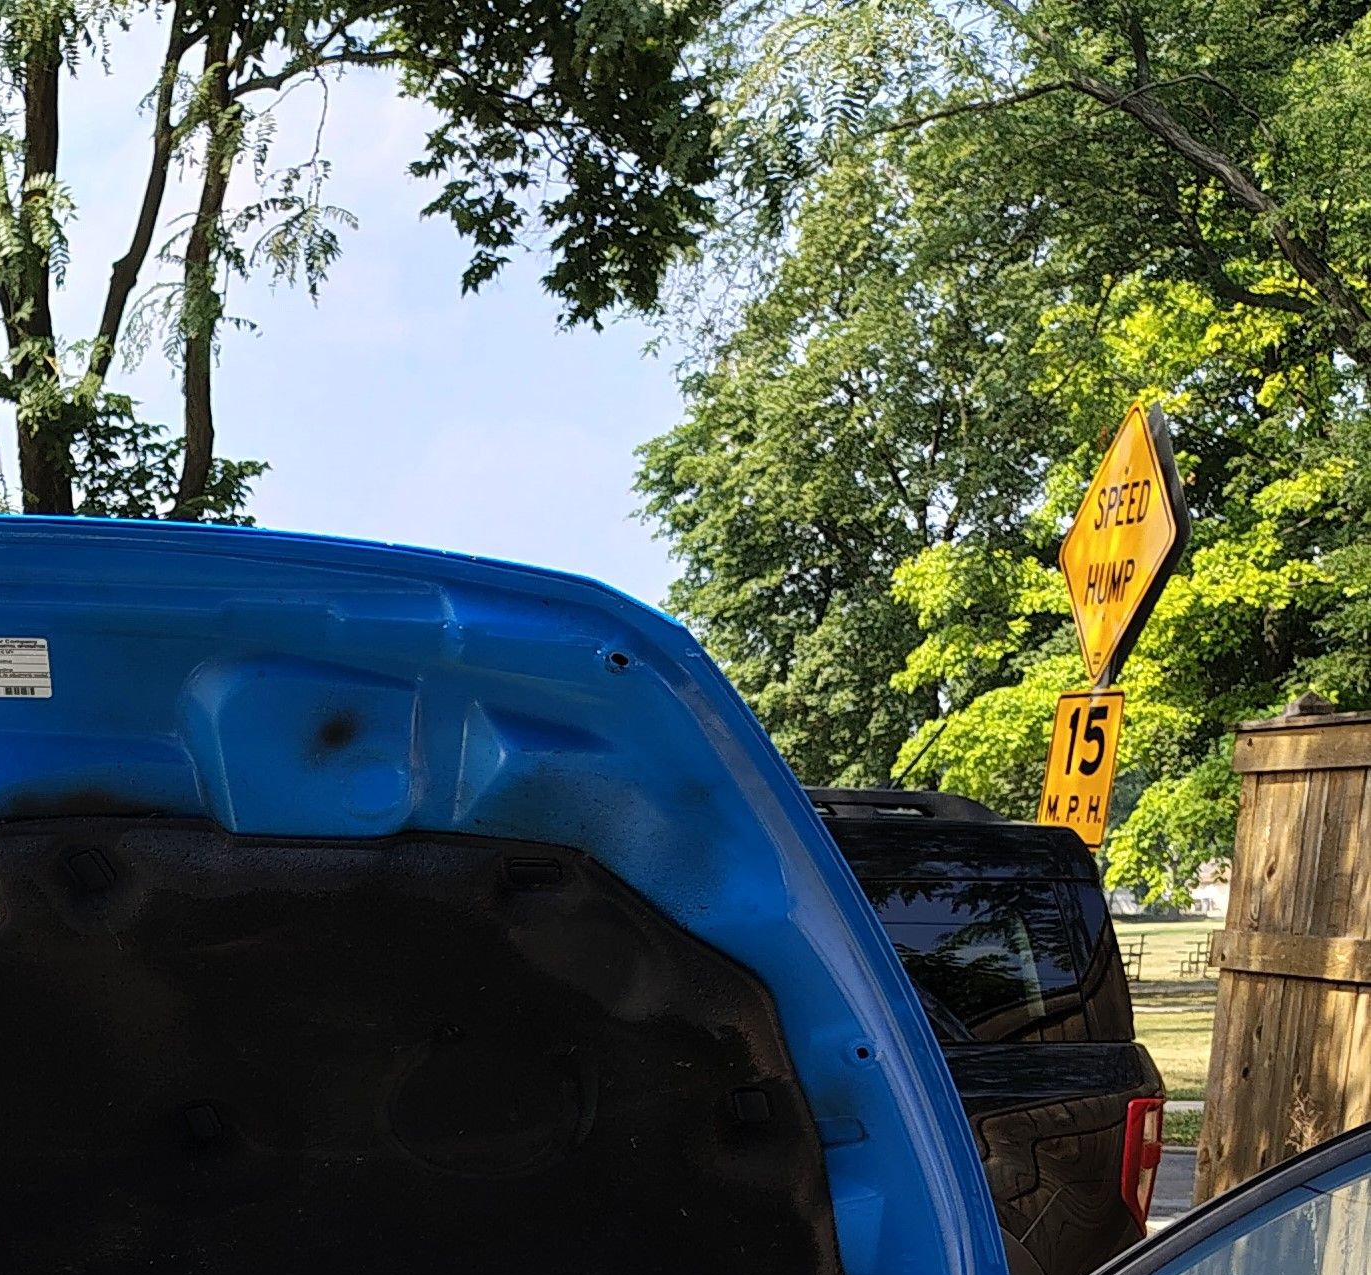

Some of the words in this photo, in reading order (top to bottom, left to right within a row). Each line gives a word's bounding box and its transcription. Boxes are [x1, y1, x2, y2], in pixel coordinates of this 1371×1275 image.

[1093, 478, 1151, 531] SPEED
[1083, 558, 1135, 607] HUMP
[1064, 705, 1109, 777] 15
